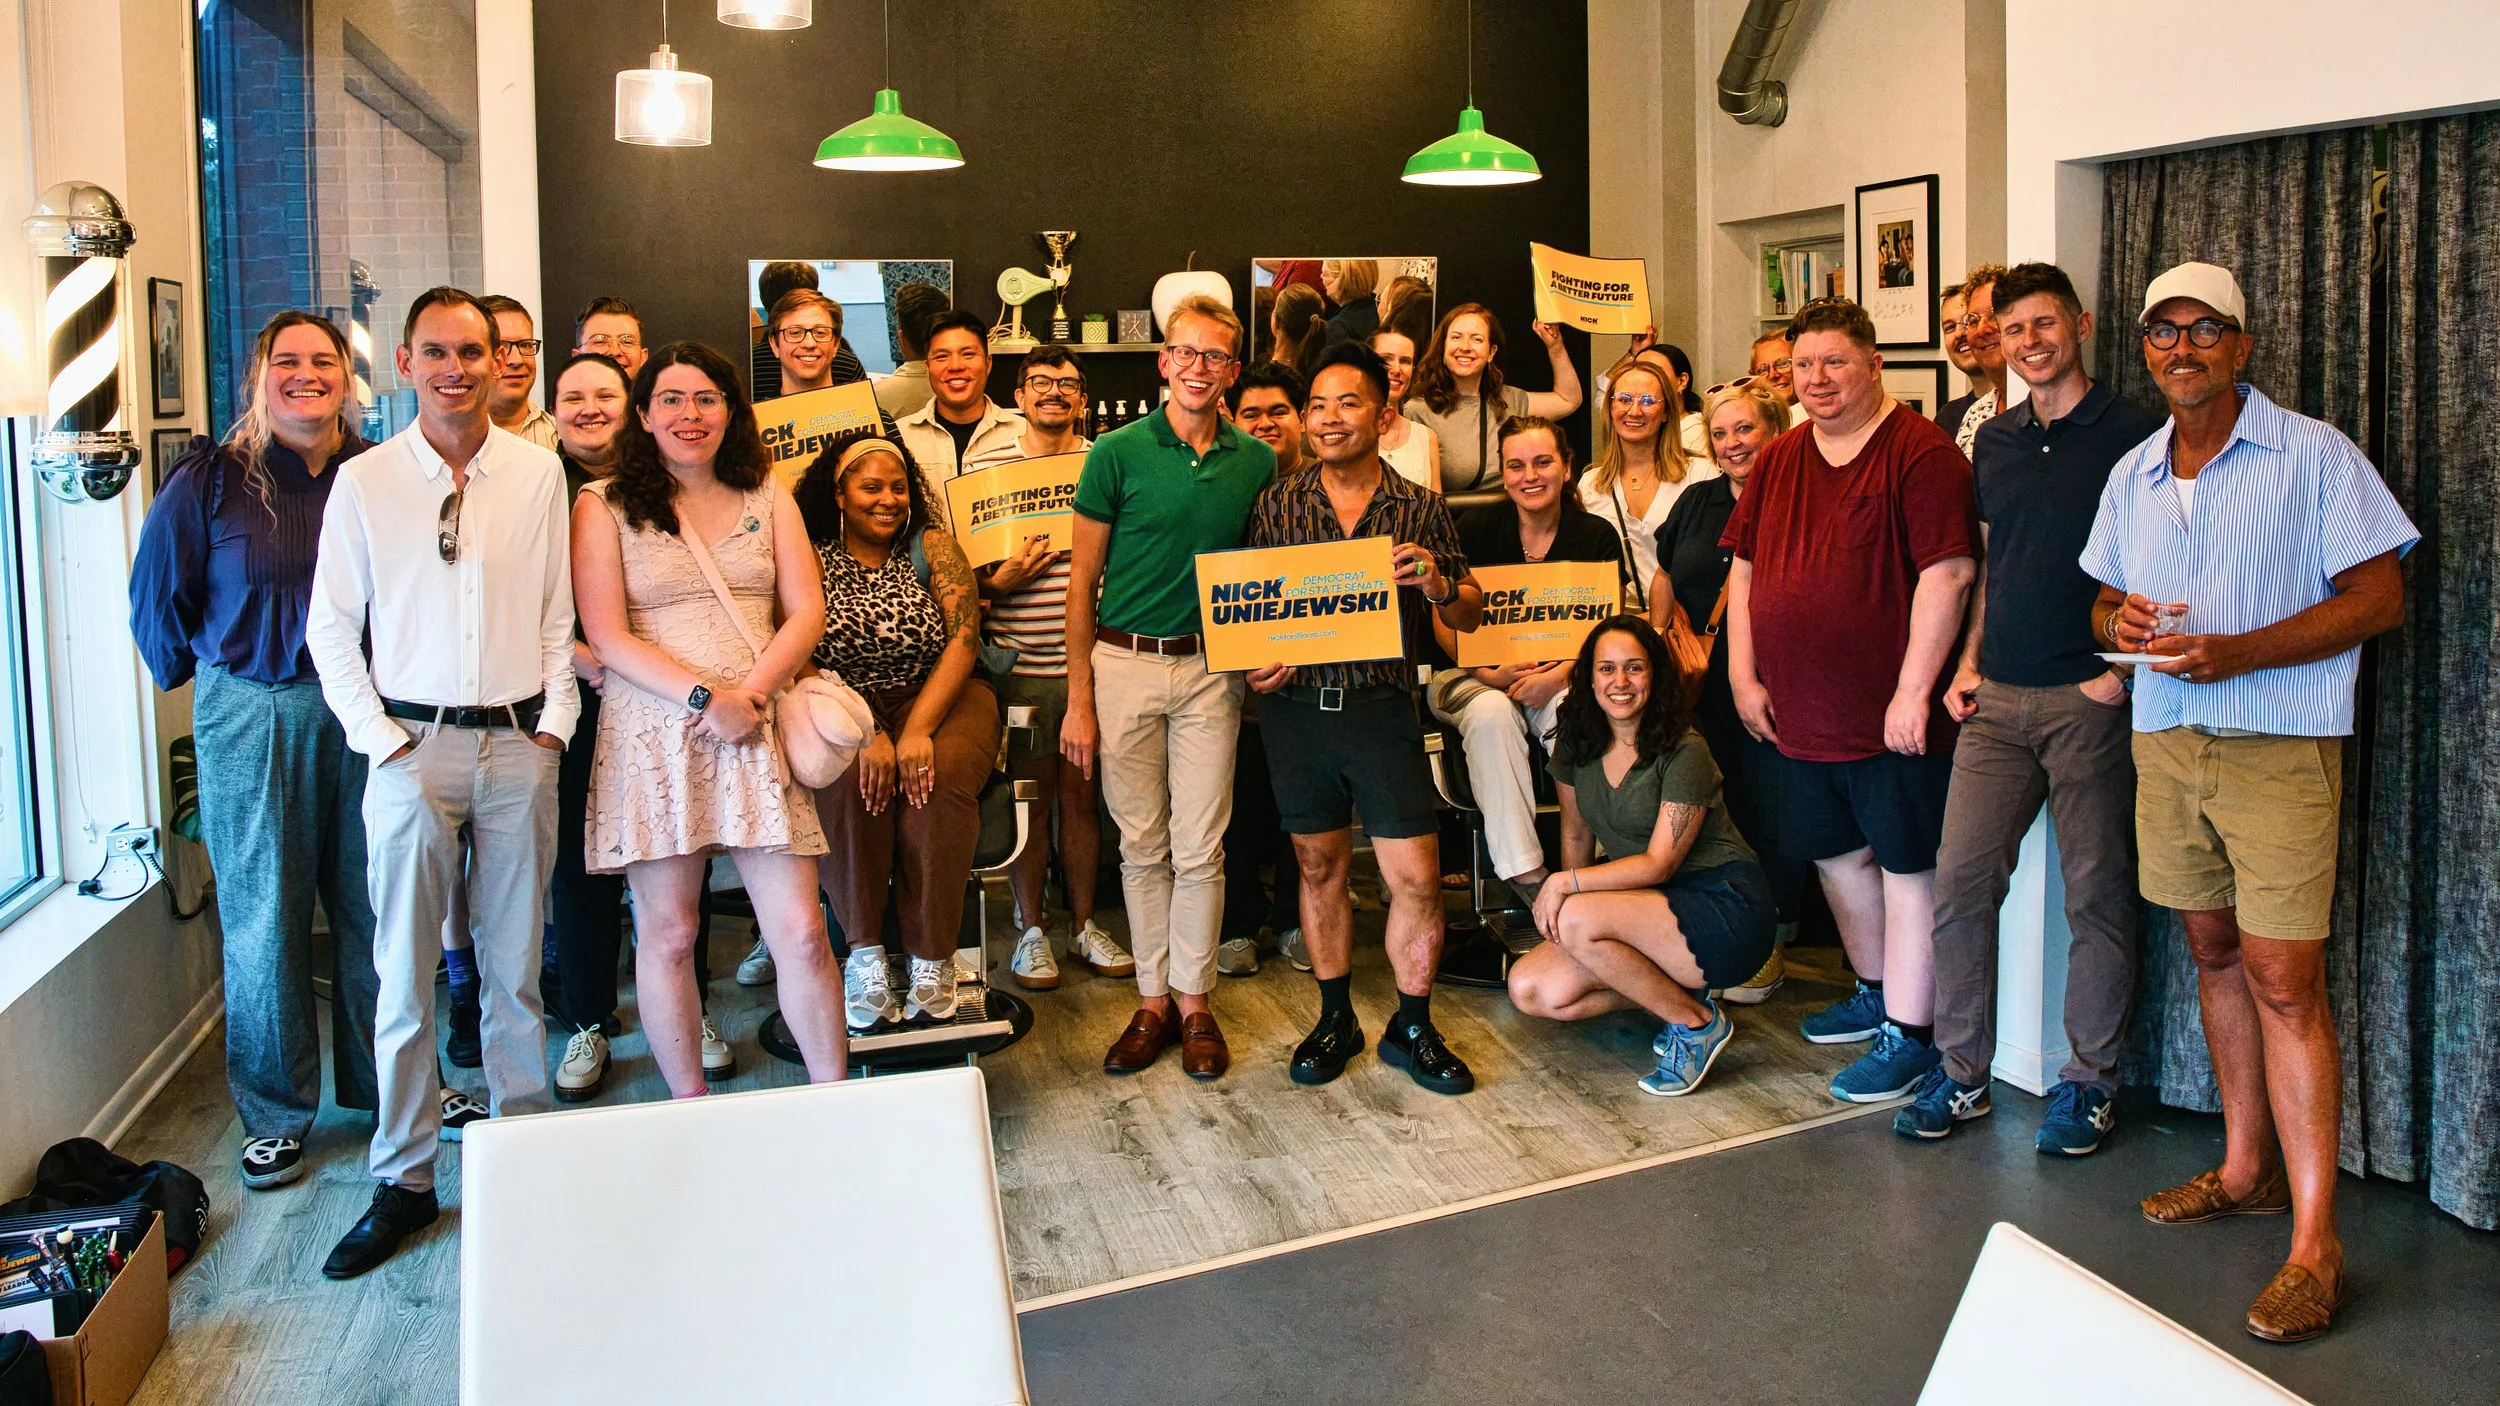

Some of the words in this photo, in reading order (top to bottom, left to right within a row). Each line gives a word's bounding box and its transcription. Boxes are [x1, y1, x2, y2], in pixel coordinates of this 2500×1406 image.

[1550, 280, 1557, 289] A
[1558, 283, 1590, 299] BETTER
[1591, 292, 1634, 302] FUTURE
[1551, 270, 1601, 292] FIGHTING
[1603, 283, 1630, 293] FOR
[1580, 315, 1598, 325] NICK
[797, 426, 816, 438] FOR
[816, 420, 842, 433] STATE
[842, 415, 873, 428] SENATE
[809, 409, 857, 426] DEMOCRAT
[760, 422, 795, 446] CK
[971, 486, 1051, 514] FIGHTING
[970, 515, 981, 527] A
[982, 501, 1036, 523] BETTER
[1038, 497, 1074, 511] FUTU
[1285, 586, 1309, 598] FOR
[1309, 584, 1343, 596] STATE
[1344, 579, 1387, 593] SENATE
[1303, 571, 1367, 586] DEMOCRAT
[1210, 578, 1286, 605] NICK
[1483, 588, 1528, 608] ICK
[1527, 596, 1547, 605] FOR
[1547, 596, 1575, 604] STATE
[1576, 594, 1612, 604] SENATE
[1542, 586, 1597, 596] DEMOCRAT
[1212, 590, 1390, 626] UNIEJEWSKI
[1481, 602, 1614, 627] NIEJEWSKI
